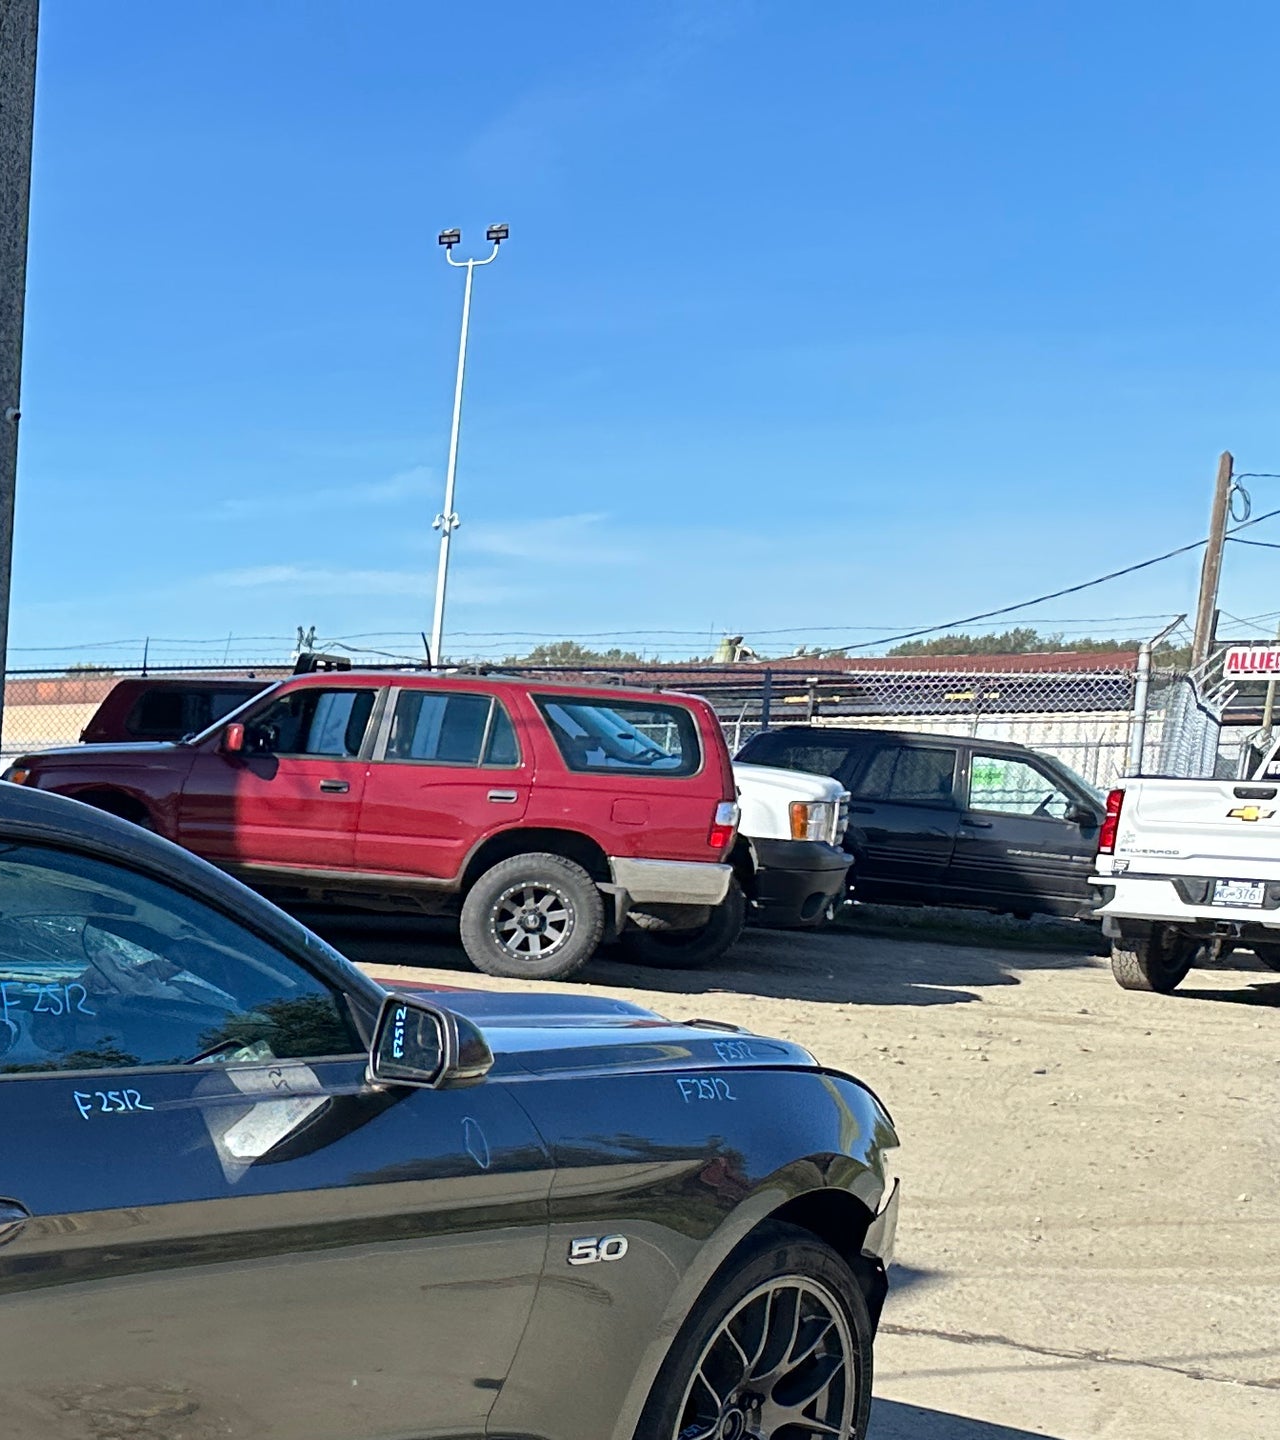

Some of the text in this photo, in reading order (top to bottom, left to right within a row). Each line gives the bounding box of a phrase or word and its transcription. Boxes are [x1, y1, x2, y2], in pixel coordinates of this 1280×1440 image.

[0, 980, 96, 1022] F2512
[393, 1006, 407, 1058] F2512
[72, 1089, 154, 1121] F2512
[676, 1077, 737, 1103] F2512
